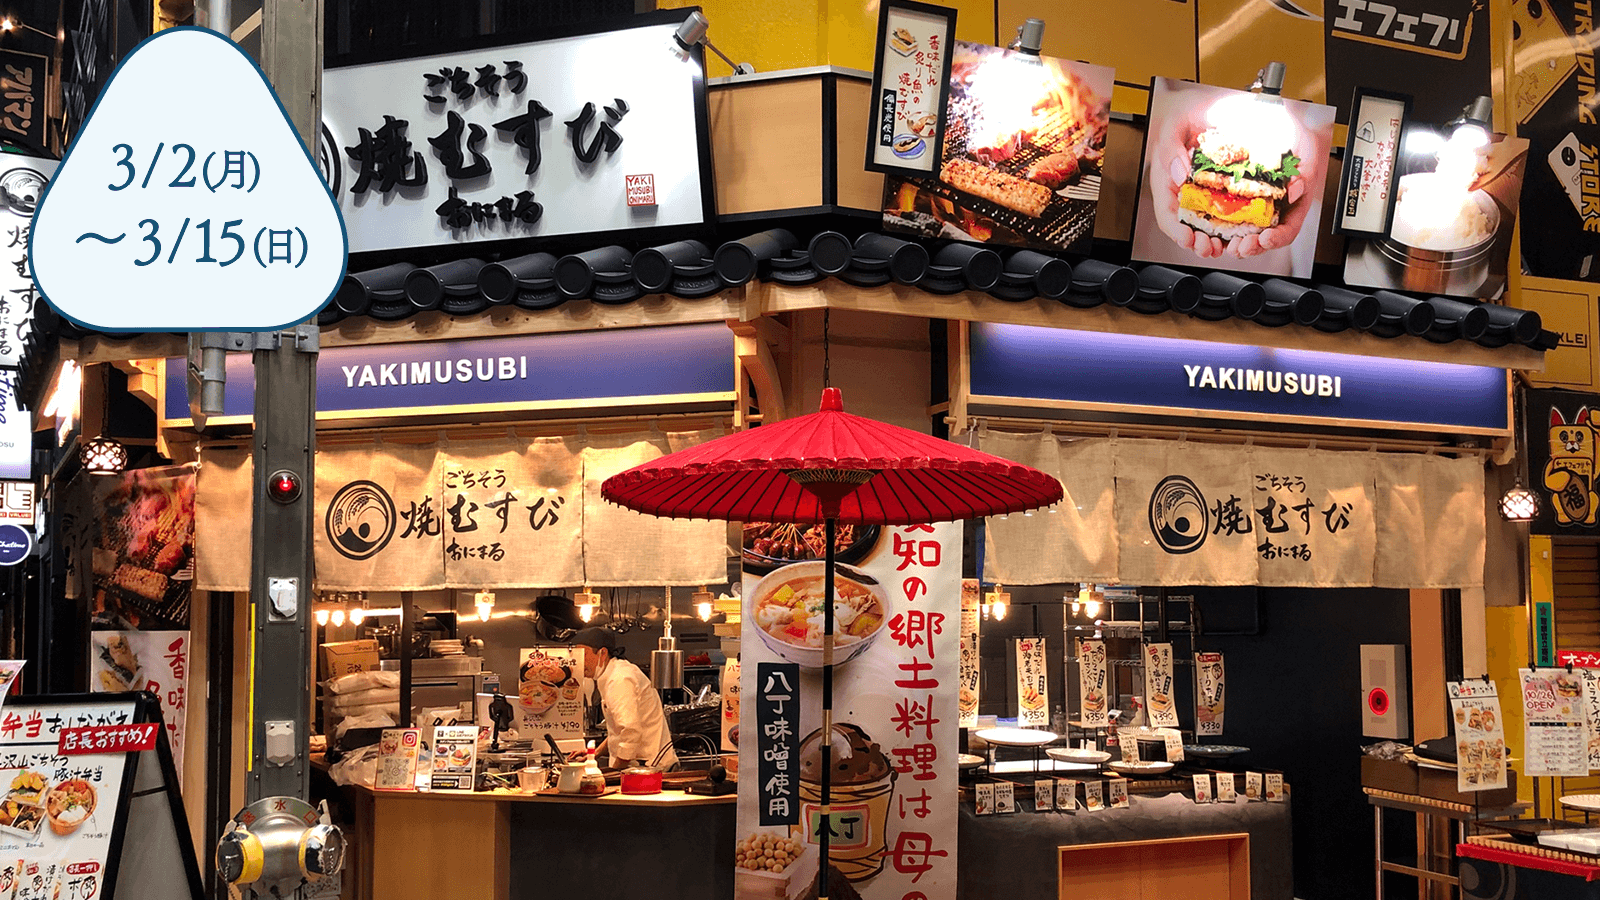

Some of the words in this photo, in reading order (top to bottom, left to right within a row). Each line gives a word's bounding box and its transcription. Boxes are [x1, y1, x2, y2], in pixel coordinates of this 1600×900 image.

[926, 34, 940, 87] 香味だれ
[423, 60, 529, 103] ごちそう
[896, 72, 911, 120] 焼むすび
[345, 98, 630, 194] 焼むすび
[626, 176, 651, 187] YAKI
[435, 187, 544, 229] おにまる
[341, 356, 528, 388] YAKIMUSUBI
[1184, 365, 1342, 398] YAKIMUSUBI
[445, 469, 507, 489] ごちそう
[1255, 472, 1307, 493] ごちそう
[400, 491, 566, 540] 焼むすび
[1210, 494, 1354, 536] 焼むすび
[446, 541, 506, 561] おにまる
[1257, 537, 1312, 562] おにまる
[1526, 700, 1554, 709] OPEN
[763, 671, 793, 818] 八丁味噌使用
[274, 799, 286, 811] 水
